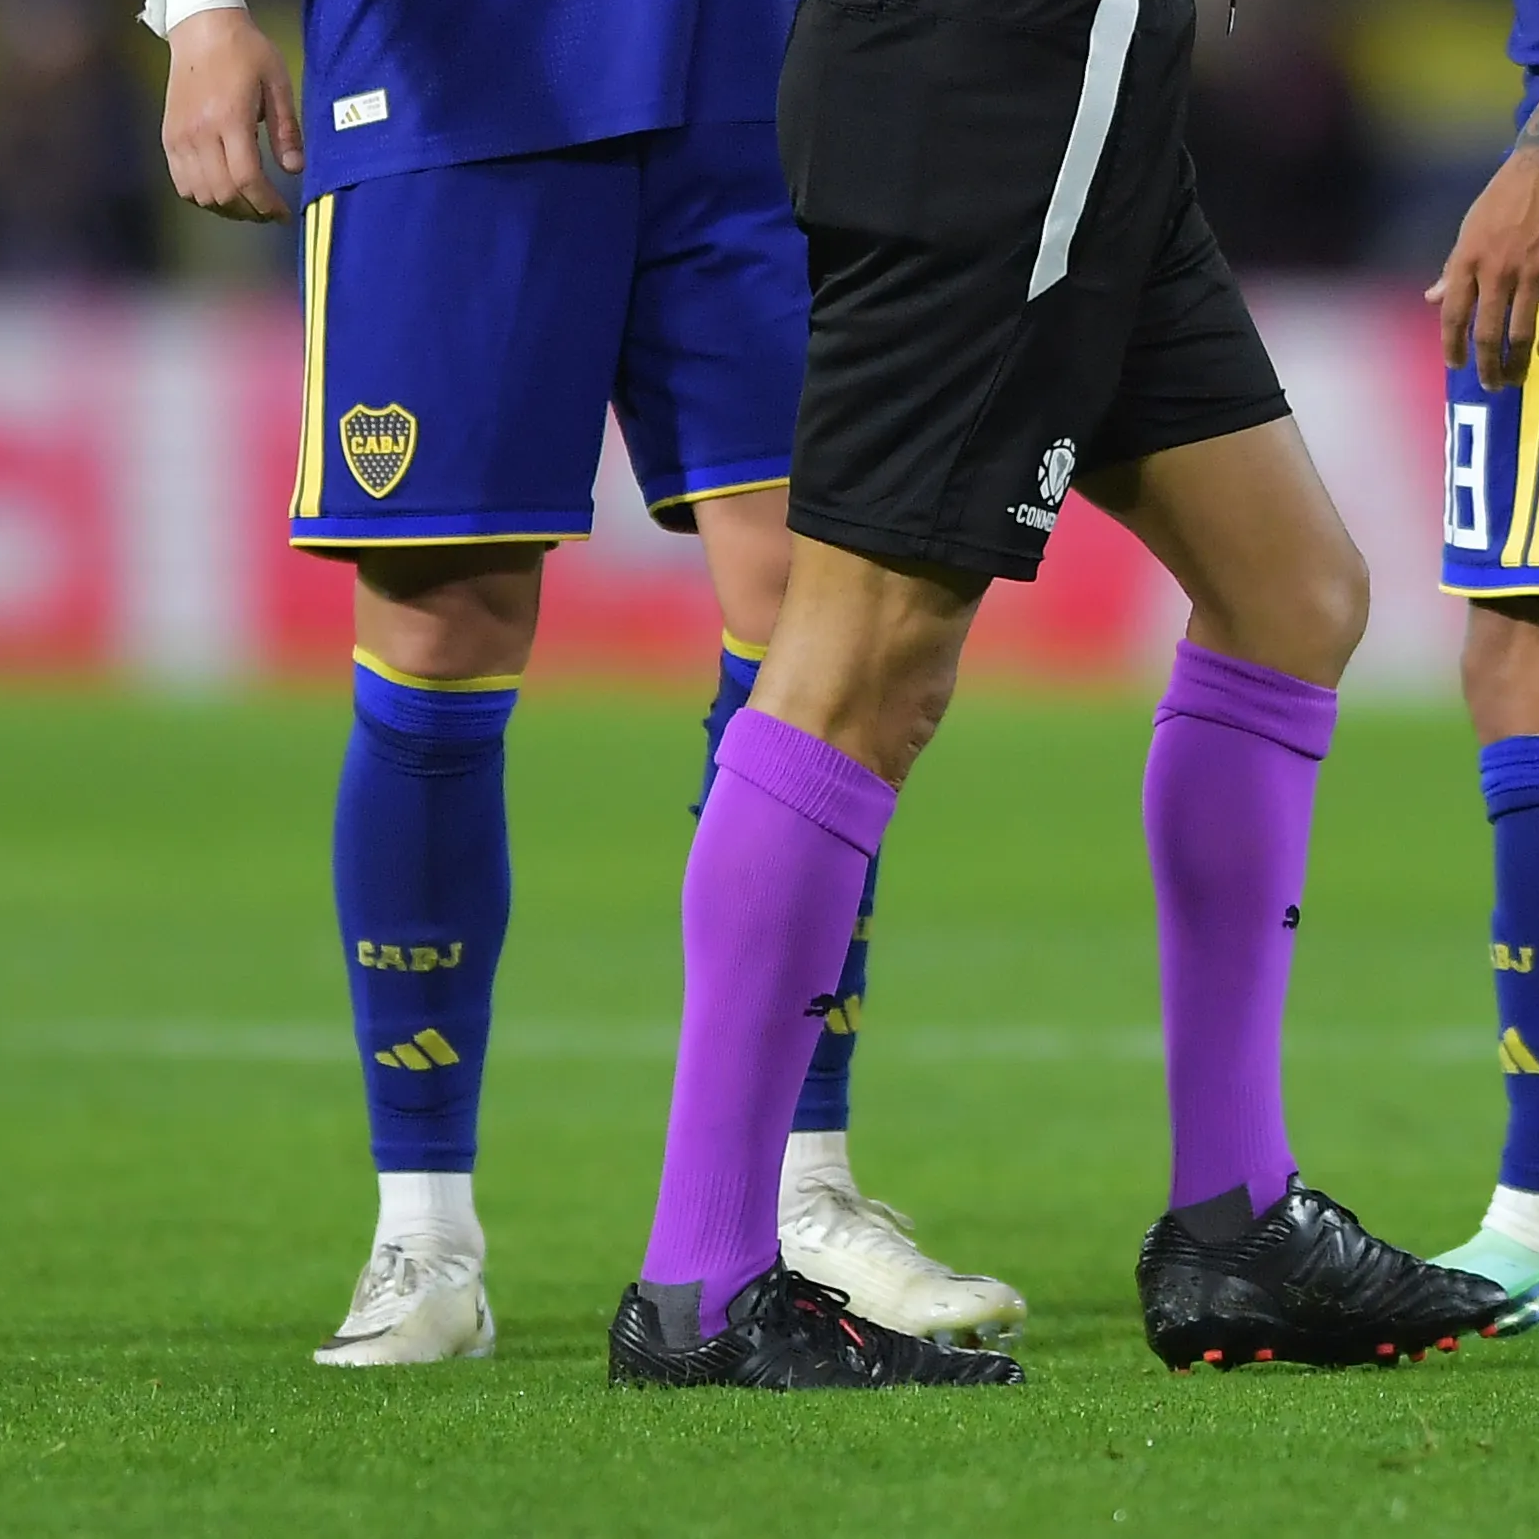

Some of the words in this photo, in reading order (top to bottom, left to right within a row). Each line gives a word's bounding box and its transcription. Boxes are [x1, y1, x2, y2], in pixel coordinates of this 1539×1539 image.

[350, 435, 406, 455] CABJ
[357, 940, 463, 972] CABJ
[1490, 943, 1533, 974] BJ
